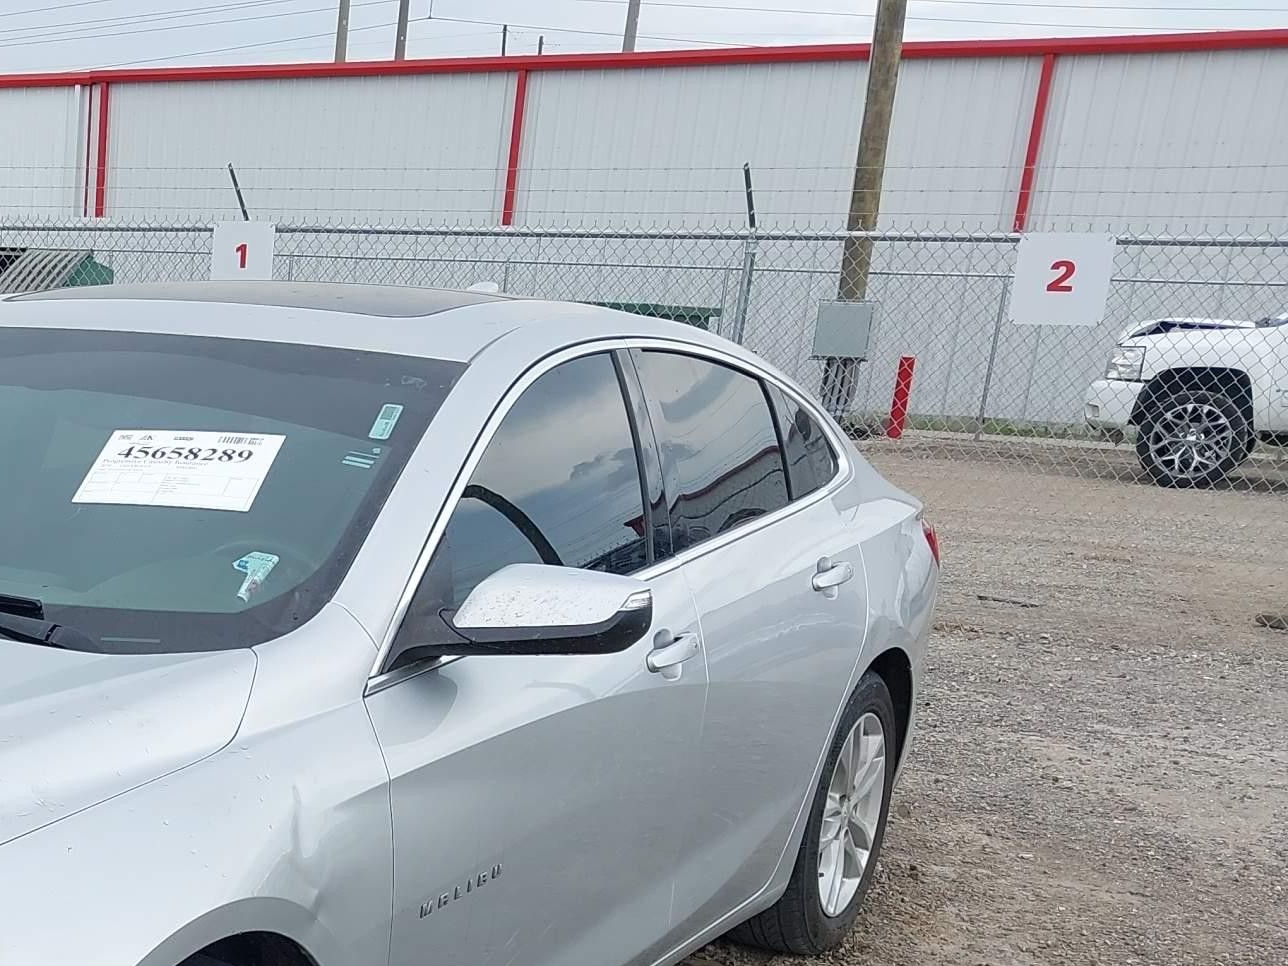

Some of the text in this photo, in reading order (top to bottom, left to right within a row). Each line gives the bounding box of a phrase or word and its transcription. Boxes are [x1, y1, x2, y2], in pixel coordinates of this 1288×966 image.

[235, 243, 247, 269] 1
[1046, 260, 1076, 292] 2
[117, 446, 254, 464] 45658289
[419, 863, 502, 919] MALIBU
